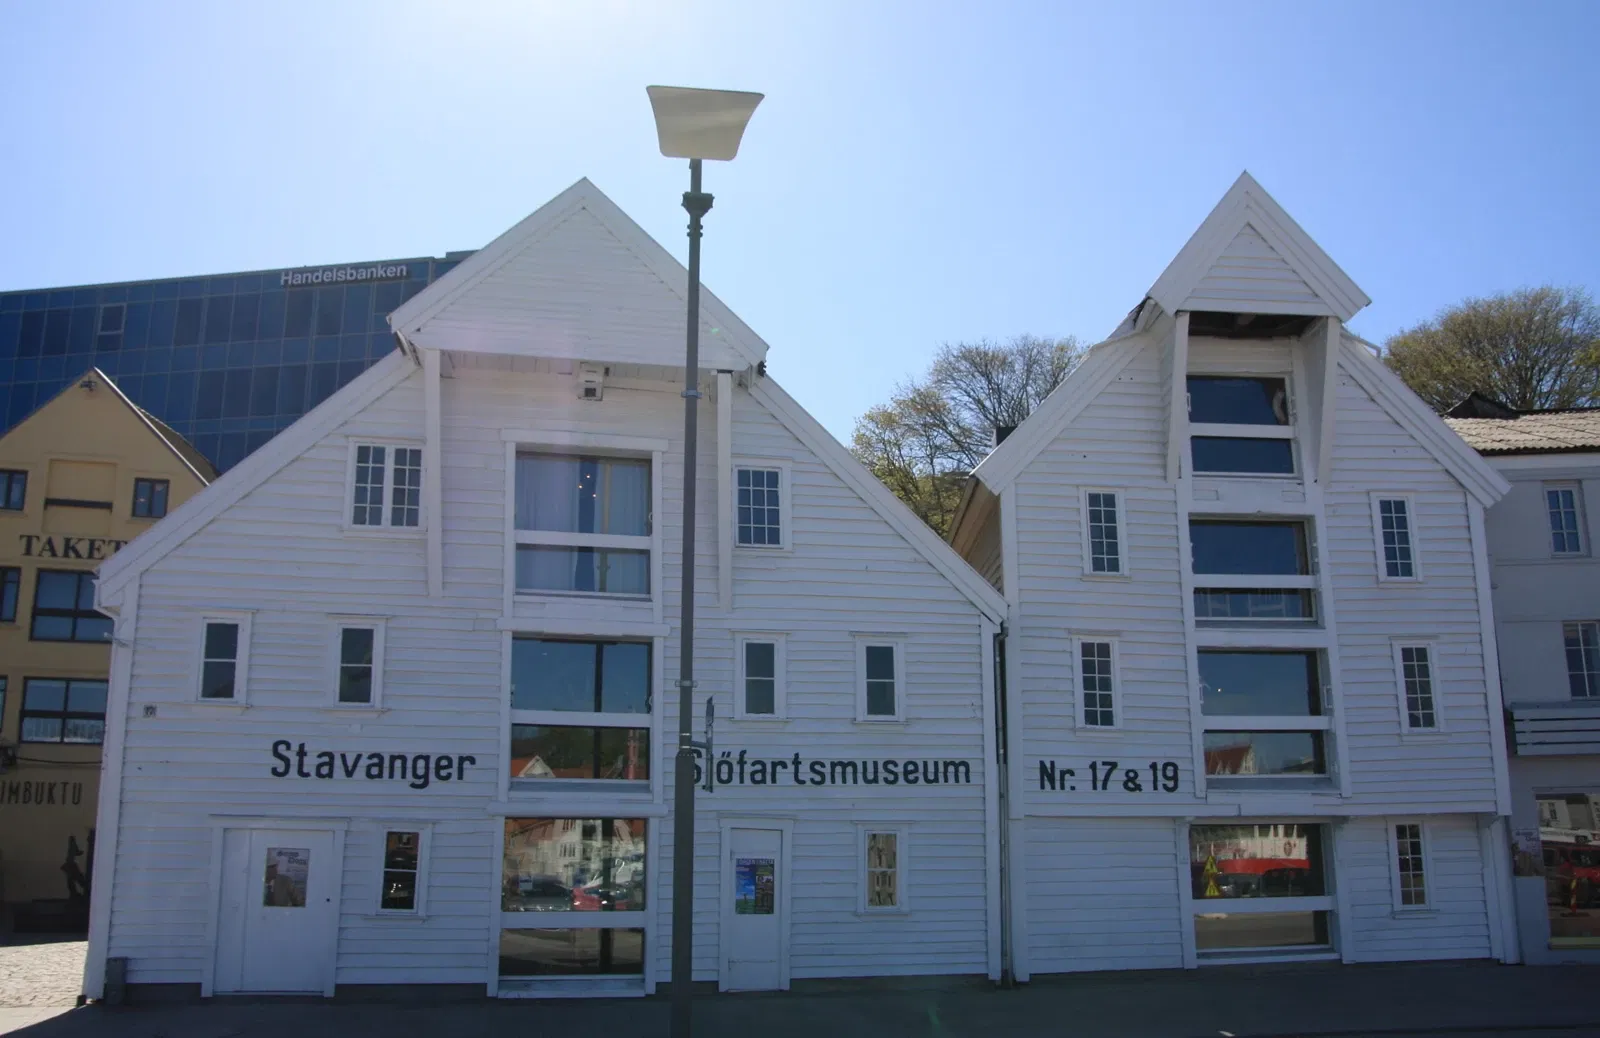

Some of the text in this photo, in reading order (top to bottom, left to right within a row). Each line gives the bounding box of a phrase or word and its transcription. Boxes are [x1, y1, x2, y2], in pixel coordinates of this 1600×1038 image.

[280, 264, 407, 286] Handelsbanken
[271, 739, 477, 790] Stavanger
[1039, 760, 1076, 791] Nr.
